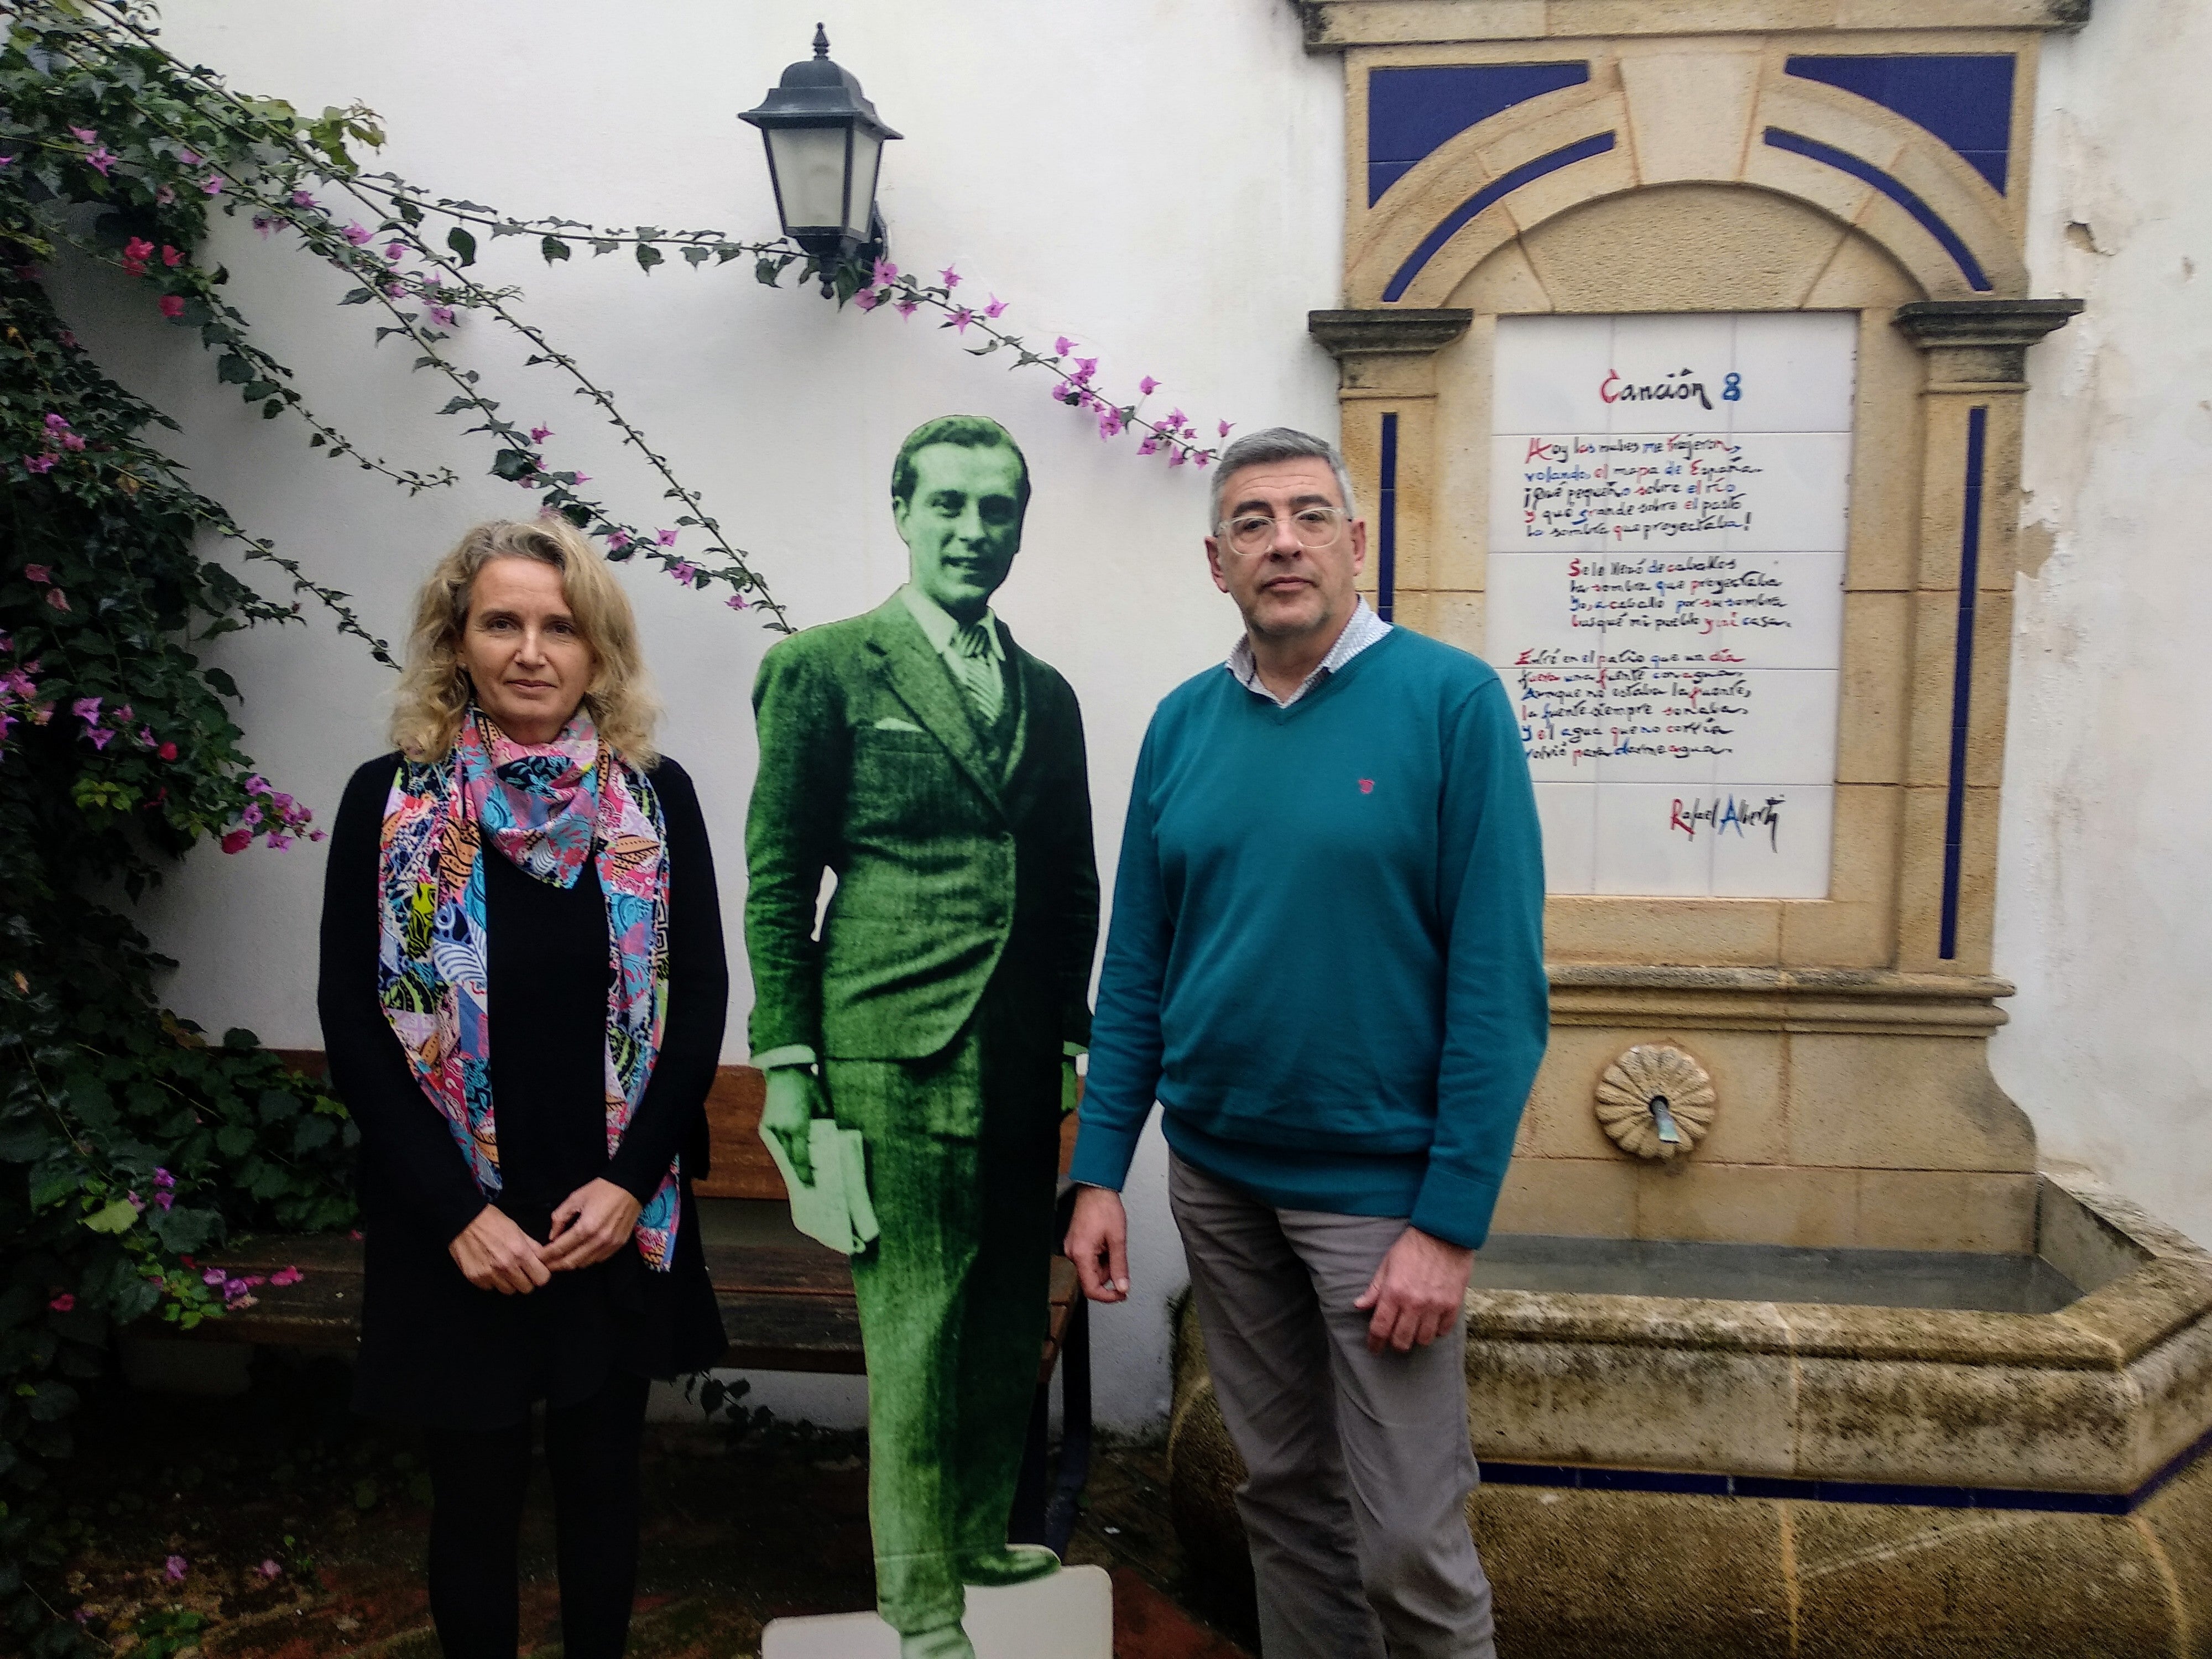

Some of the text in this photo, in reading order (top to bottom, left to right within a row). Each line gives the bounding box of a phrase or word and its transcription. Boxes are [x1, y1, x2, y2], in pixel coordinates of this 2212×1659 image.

[1599, 368, 1741, 410] Canción 8
[1525, 437, 1569, 465] Hoy
[1574, 436, 1595, 453] las
[1598, 438, 1640, 453] nubes
[1642, 442, 1664, 454] me
[1594, 463, 1609, 479] el
[1613, 466, 1660, 484] mapa
[1664, 460, 1683, 477] de
[1523, 481, 1564, 511] ¡Qué
[1567, 481, 1631, 508] pequeño
[1633, 478, 1683, 496] sobre
[1686, 479, 1702, 495] el
[1571, 501, 1635, 525] grande
[1637, 497, 1677, 514] sobre
[1684, 497, 1699, 510] el
[1548, 521, 1611, 538] sombra
[1613, 524, 1640, 541] que
[1647, 559, 1665, 573] de
[1666, 555, 1738, 572] caballos
[1570, 580, 1590, 593] la
[1590, 580, 1652, 592] sombra
[1655, 580, 1684, 597] que
[1674, 598, 1700, 614] por
[1699, 599, 1723, 608] su
[1724, 593, 1788, 608] sombra
[1629, 614, 1652, 628] mi
[1655, 612, 1700, 632] pueblo
[1698, 617, 1714, 635] y
[1514, 647, 1562, 665] Entré
[1581, 649, 1596, 664] el
[1596, 648, 1646, 669] patio
[1650, 653, 1680, 669] que
[1708, 648, 1747, 662] día
[1520, 687, 1583, 706] Aunque
[1585, 690, 1606, 698] no
[1611, 682, 1667, 698] estaba
[1671, 682, 1689, 697] la
[1522, 704, 1538, 721] la
[1537, 722, 1554, 740] el
[1561, 727, 1603, 744] agua
[1610, 724, 1638, 747] que
[1639, 726, 1661, 734] no
[1665, 717, 1735, 735] corría
[1572, 747, 1614, 772] para
[1614, 737, 1667, 758] darme
[1670, 793, 1787, 853] Rafael Alberti
